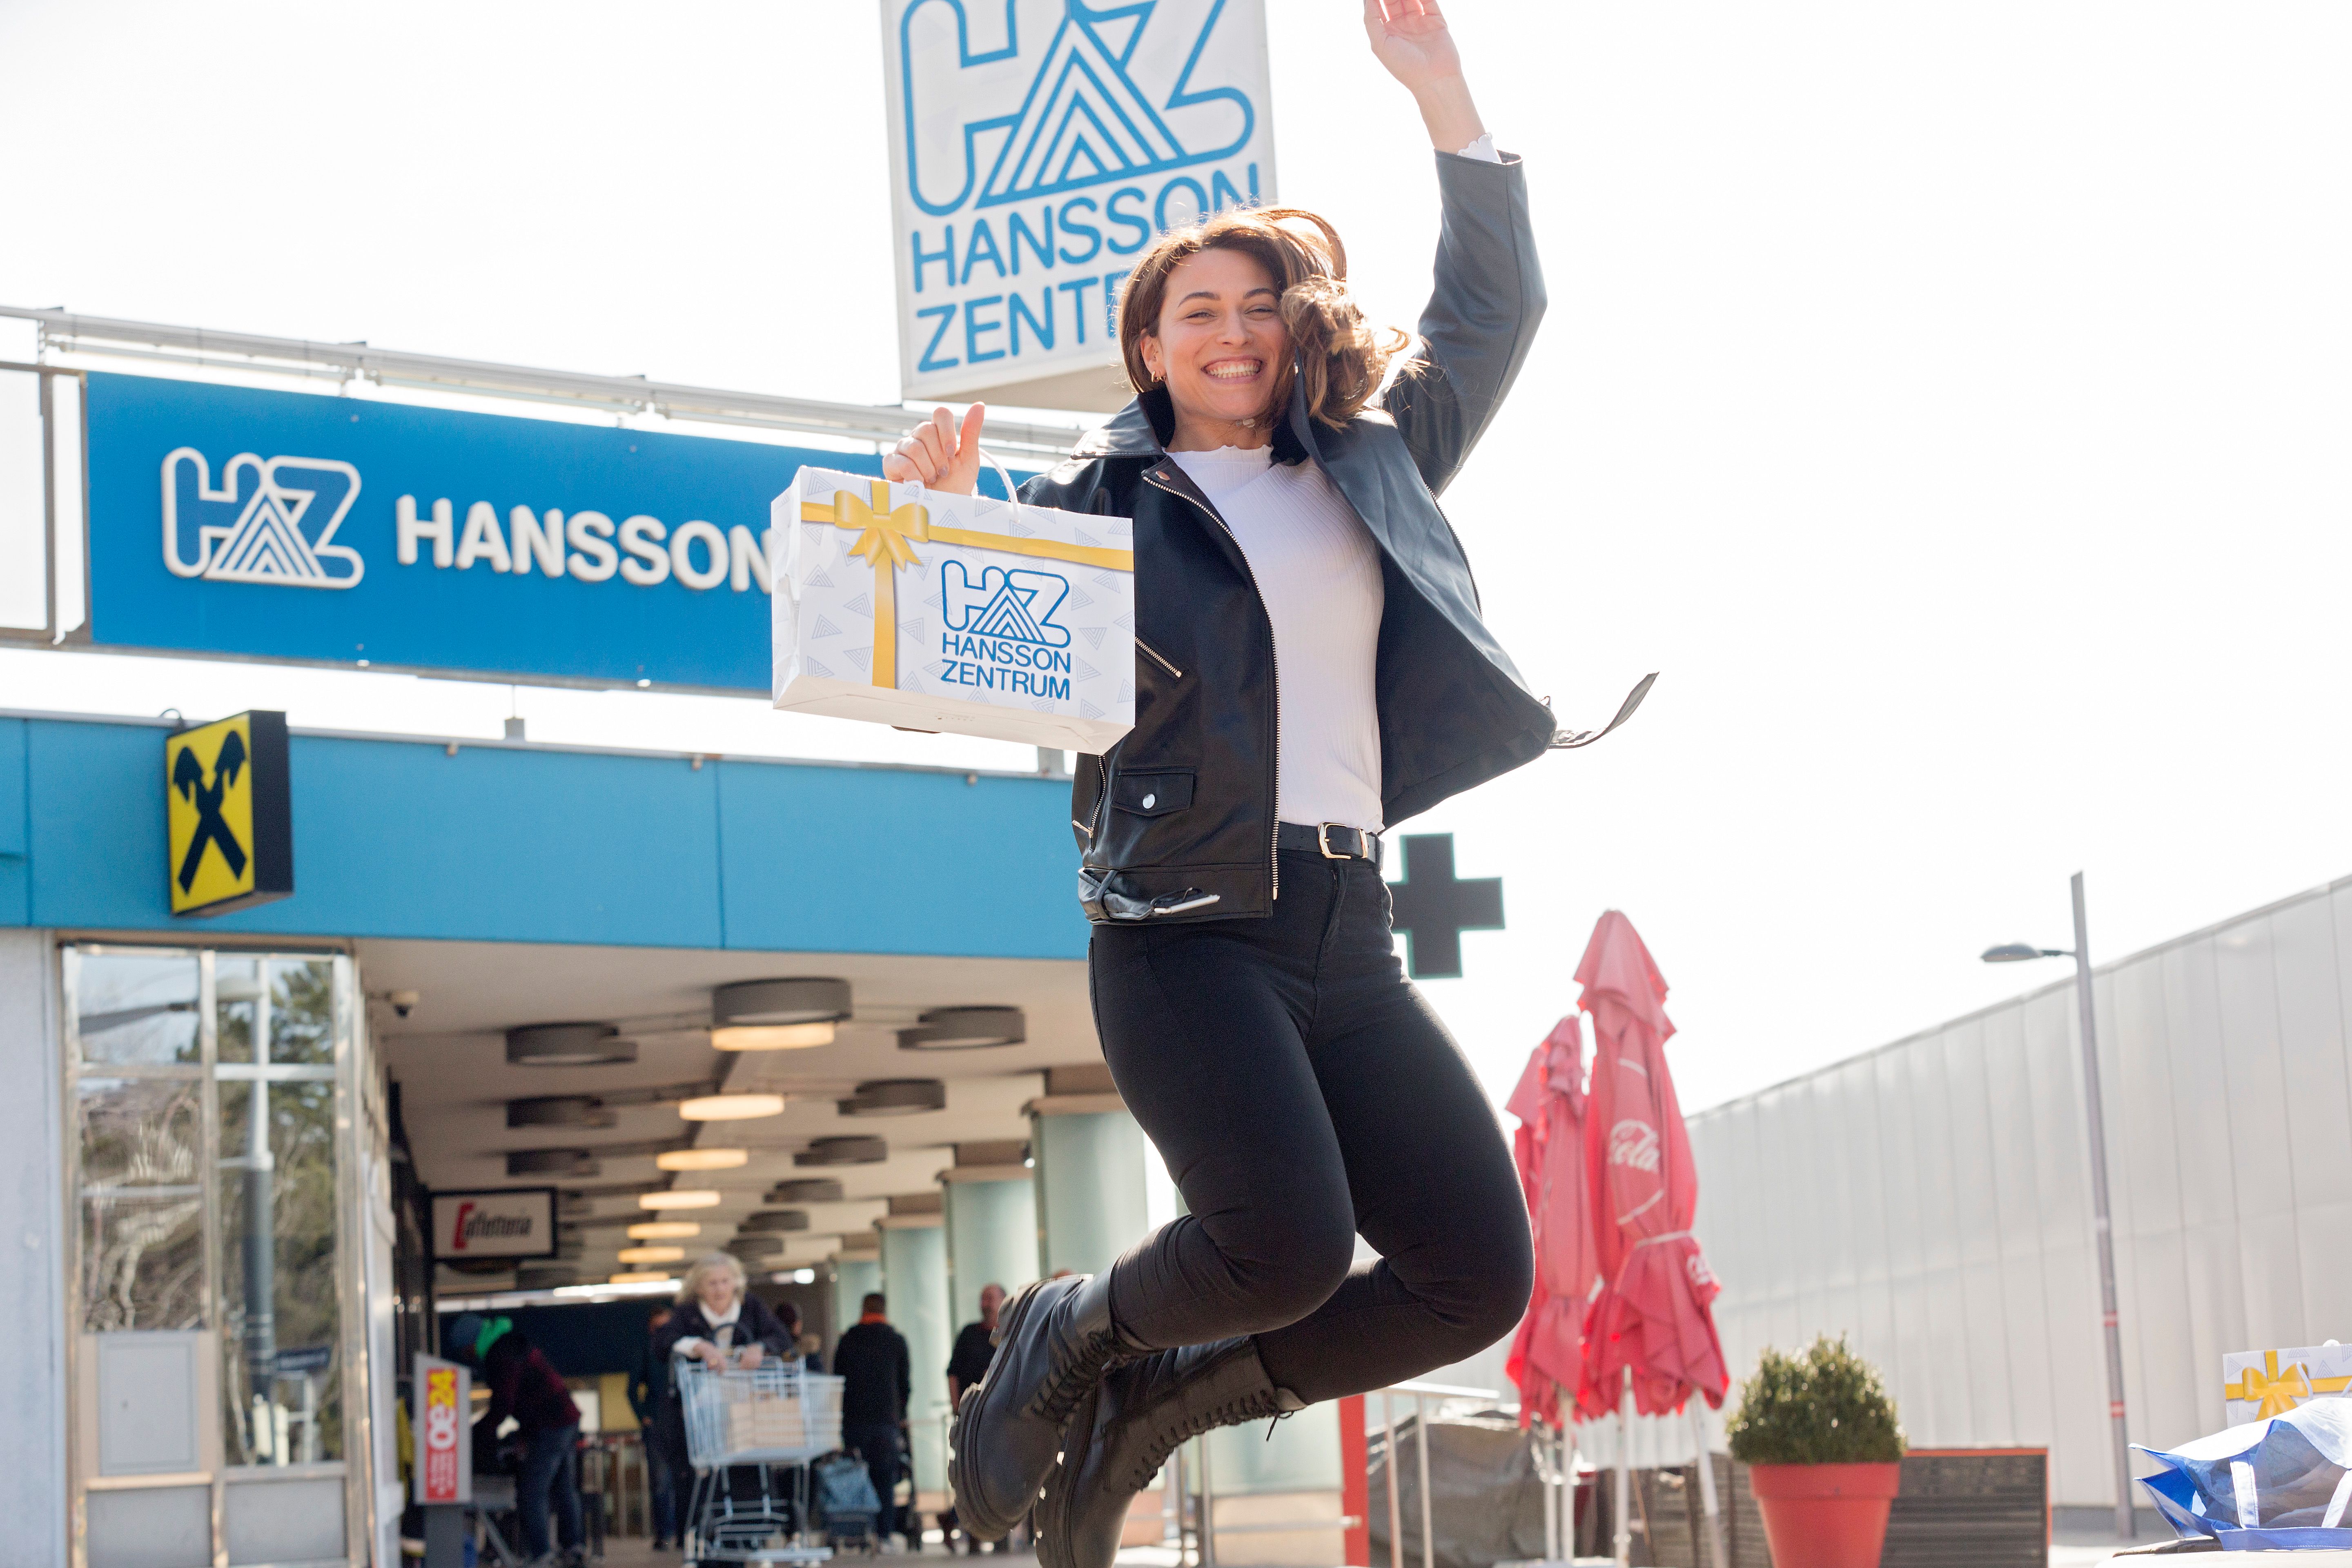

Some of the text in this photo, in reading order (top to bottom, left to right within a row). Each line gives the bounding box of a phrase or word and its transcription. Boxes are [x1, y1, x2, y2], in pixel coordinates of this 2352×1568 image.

[917, 270, 1132, 372] ZENT
[395, 494, 772, 595] HANSSON
[940, 659, 1070, 701] ZENTRUM
[942, 632, 1071, 674] HANSSON
